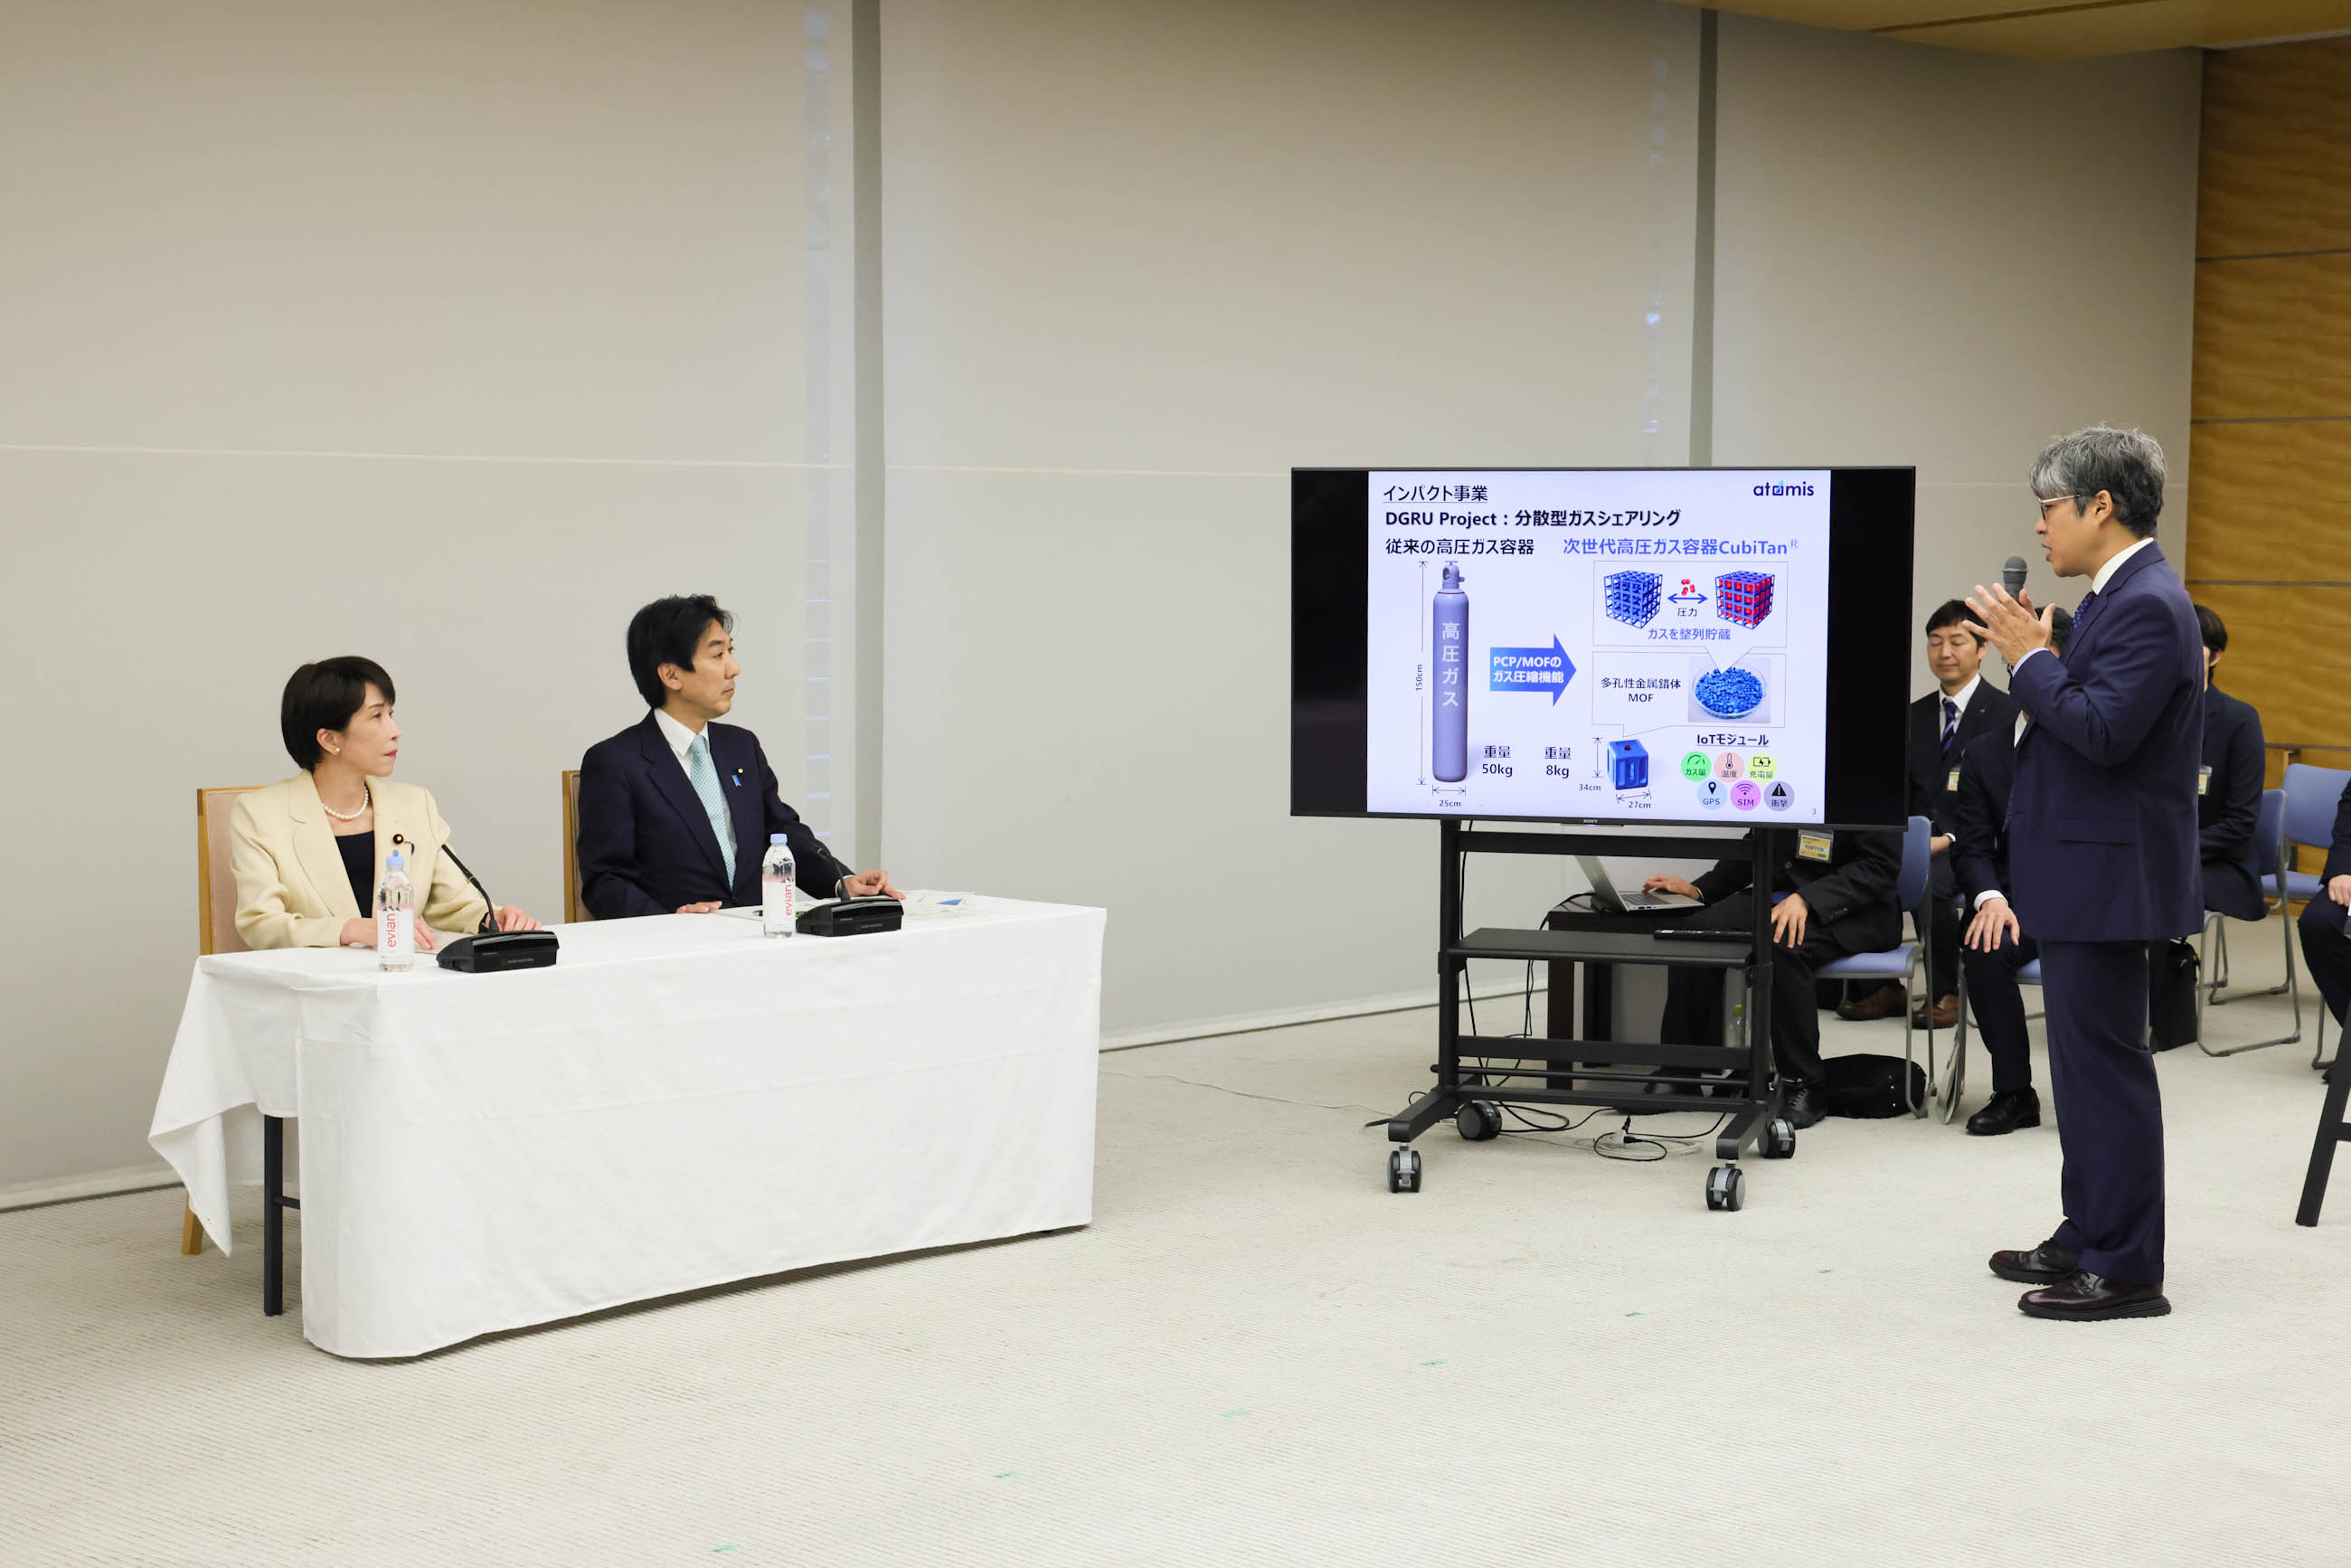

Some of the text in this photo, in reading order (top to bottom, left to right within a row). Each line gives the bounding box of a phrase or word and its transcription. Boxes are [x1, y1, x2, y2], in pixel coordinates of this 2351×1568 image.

[1383, 485, 1488, 502] インパクト事業
[1753, 480, 1815, 496] atomis
[1385, 512, 1433, 525] DGRU
[1440, 511, 1497, 529] Project
[1515, 509, 1682, 527] 分散型ガスシェアリング
[1385, 538, 1534, 554] 従来の高圧ガス容器
[1676, 608, 1698, 618] 圧力
[1648, 628, 1732, 641] ガスを整列貯蔵
[1441, 621, 1461, 707] 高圧ガス
[1493, 656, 1563, 668] PCP/MOFの
[1415, 664, 1423, 692] 150cm
[1493, 670, 1564, 683] ガス圧縮機能
[1600, 677, 1682, 690] 多孔性金属錯体
[1628, 693, 1654, 703] MOF
[1696, 733, 1770, 746] IoTモジュール
[1484, 745, 1511, 759] 重量
[1544, 746, 1572, 760] 重量
[1482, 763, 1513, 778] 50kg
[1545, 764, 1570, 779] 8kg
[1685, 768, 1706, 777] ガス量
[1579, 783, 1601, 791] 34cm
[1439, 799, 1462, 808] 25cm
[1628, 800, 1651, 809] 27cm
[1703, 798, 1721, 806] GPS
[1737, 798, 1754, 807] SIM
[785, 883, 793, 917] evian
[387, 912, 398, 948] evian
